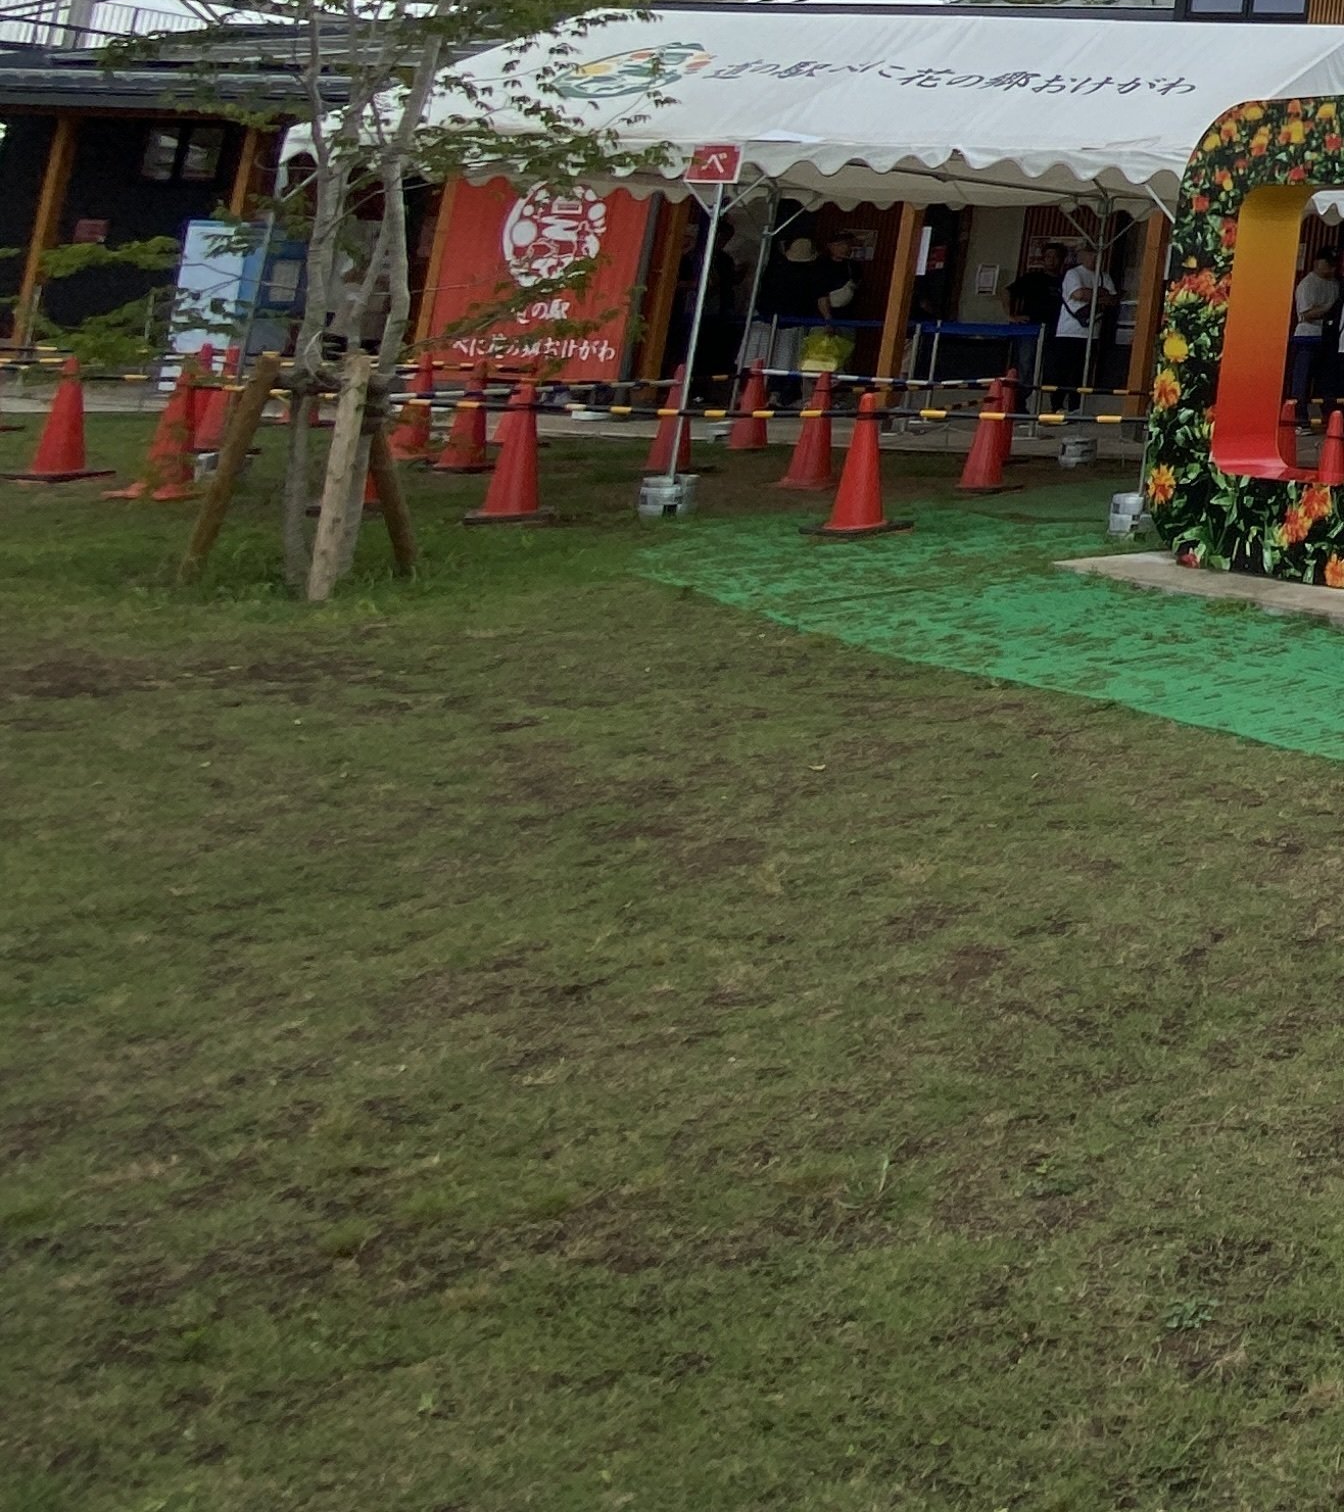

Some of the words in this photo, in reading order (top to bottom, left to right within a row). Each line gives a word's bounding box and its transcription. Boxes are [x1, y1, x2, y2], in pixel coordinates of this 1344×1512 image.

[707, 59, 1196, 96] 道の駅べに花の郷おけがわ
